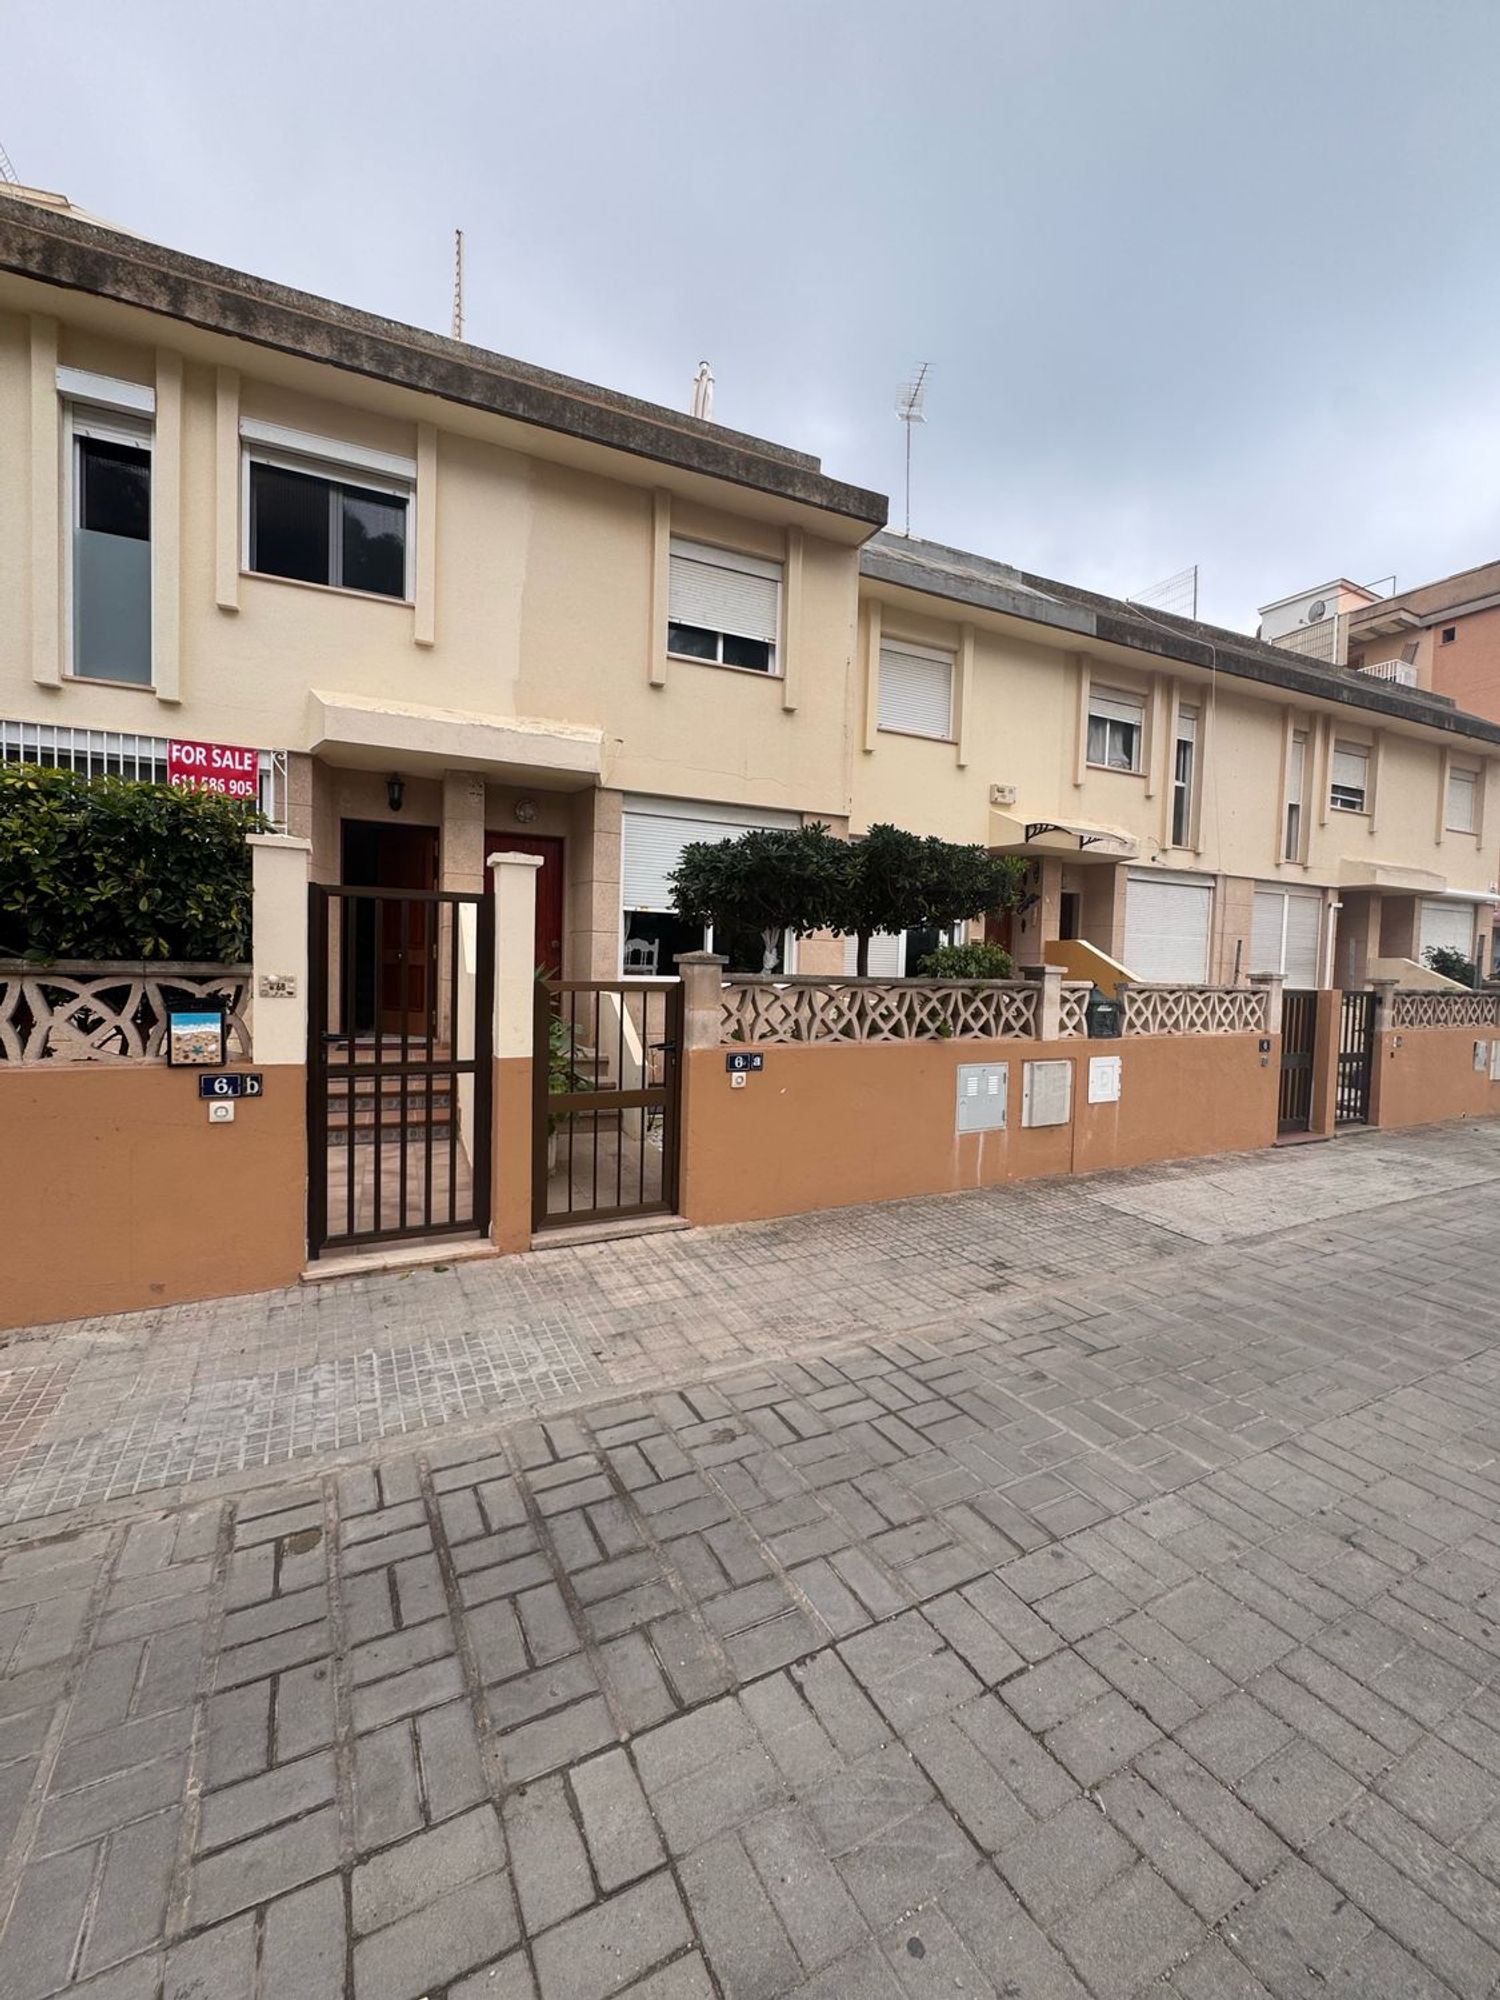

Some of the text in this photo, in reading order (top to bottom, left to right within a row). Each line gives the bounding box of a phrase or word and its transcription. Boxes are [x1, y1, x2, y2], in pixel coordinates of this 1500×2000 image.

[171, 744, 253, 771] FOR SALE
[229, 779, 253, 796] 905
[246, 1076, 260, 1094] b
